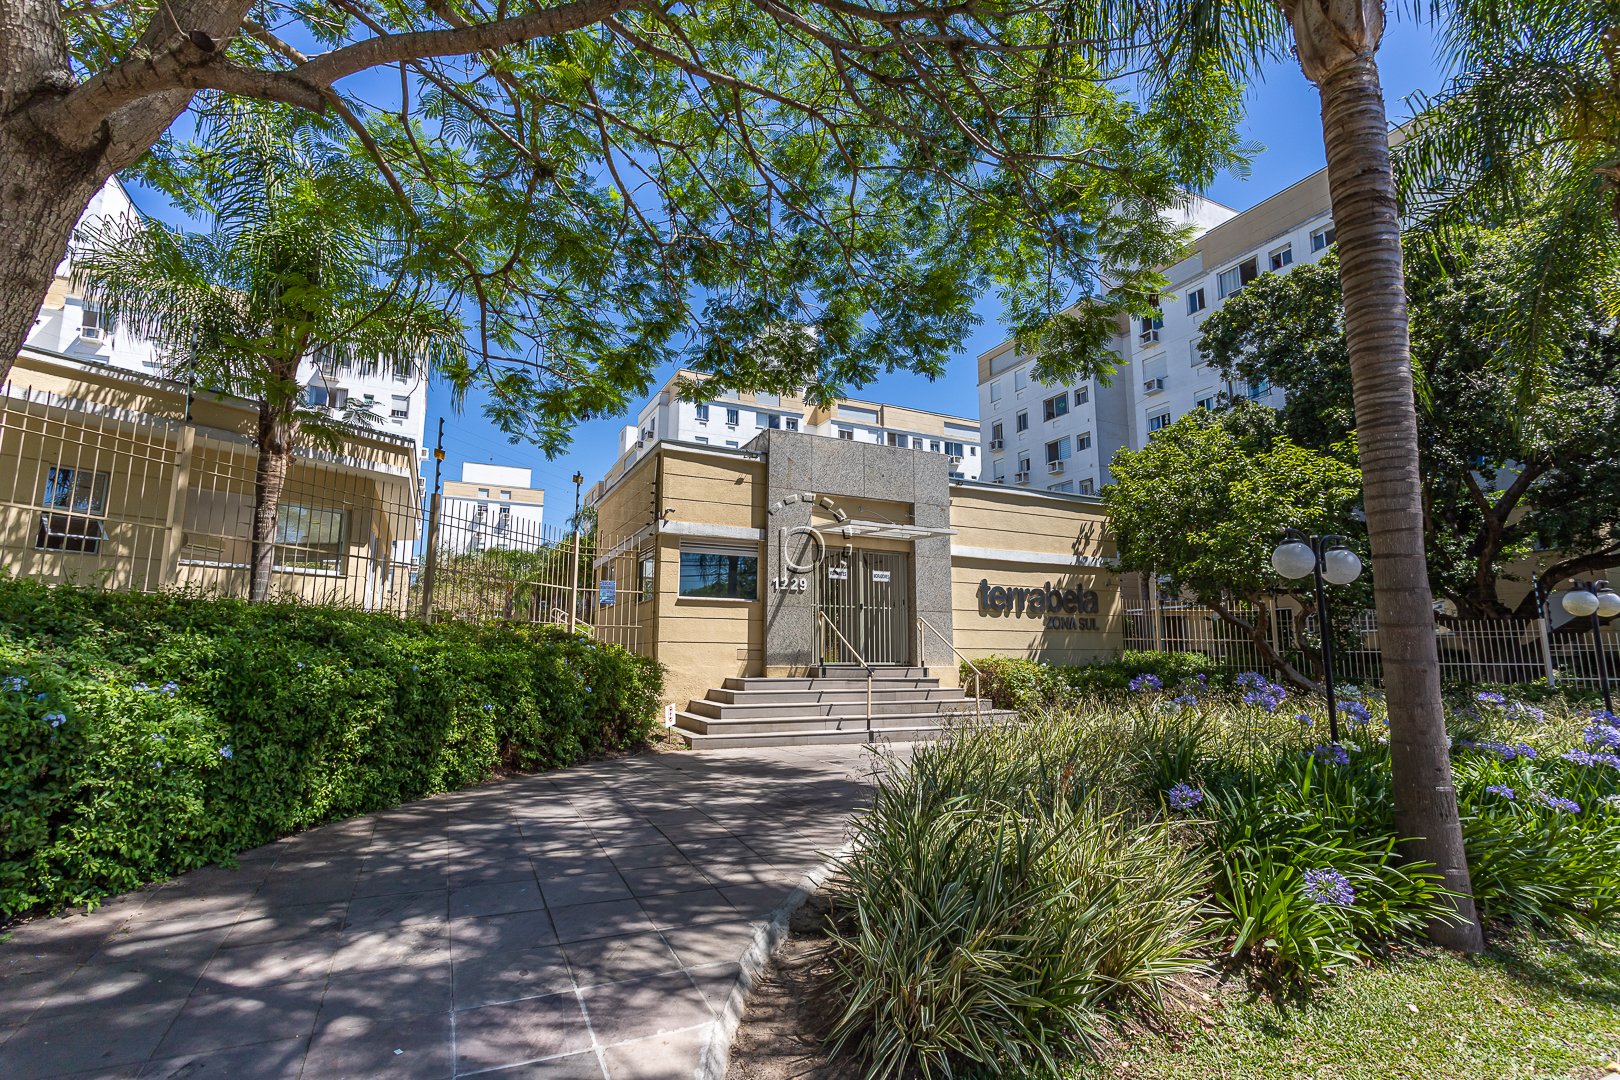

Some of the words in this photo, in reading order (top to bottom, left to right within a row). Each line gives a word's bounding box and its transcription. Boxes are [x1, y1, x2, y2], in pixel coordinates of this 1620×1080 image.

[772, 576, 808, 591] 1229
[979, 578, 1099, 614] terrabela
[1046, 616, 1077, 630] ZONA
[1078, 616, 1100, 631] SUL
